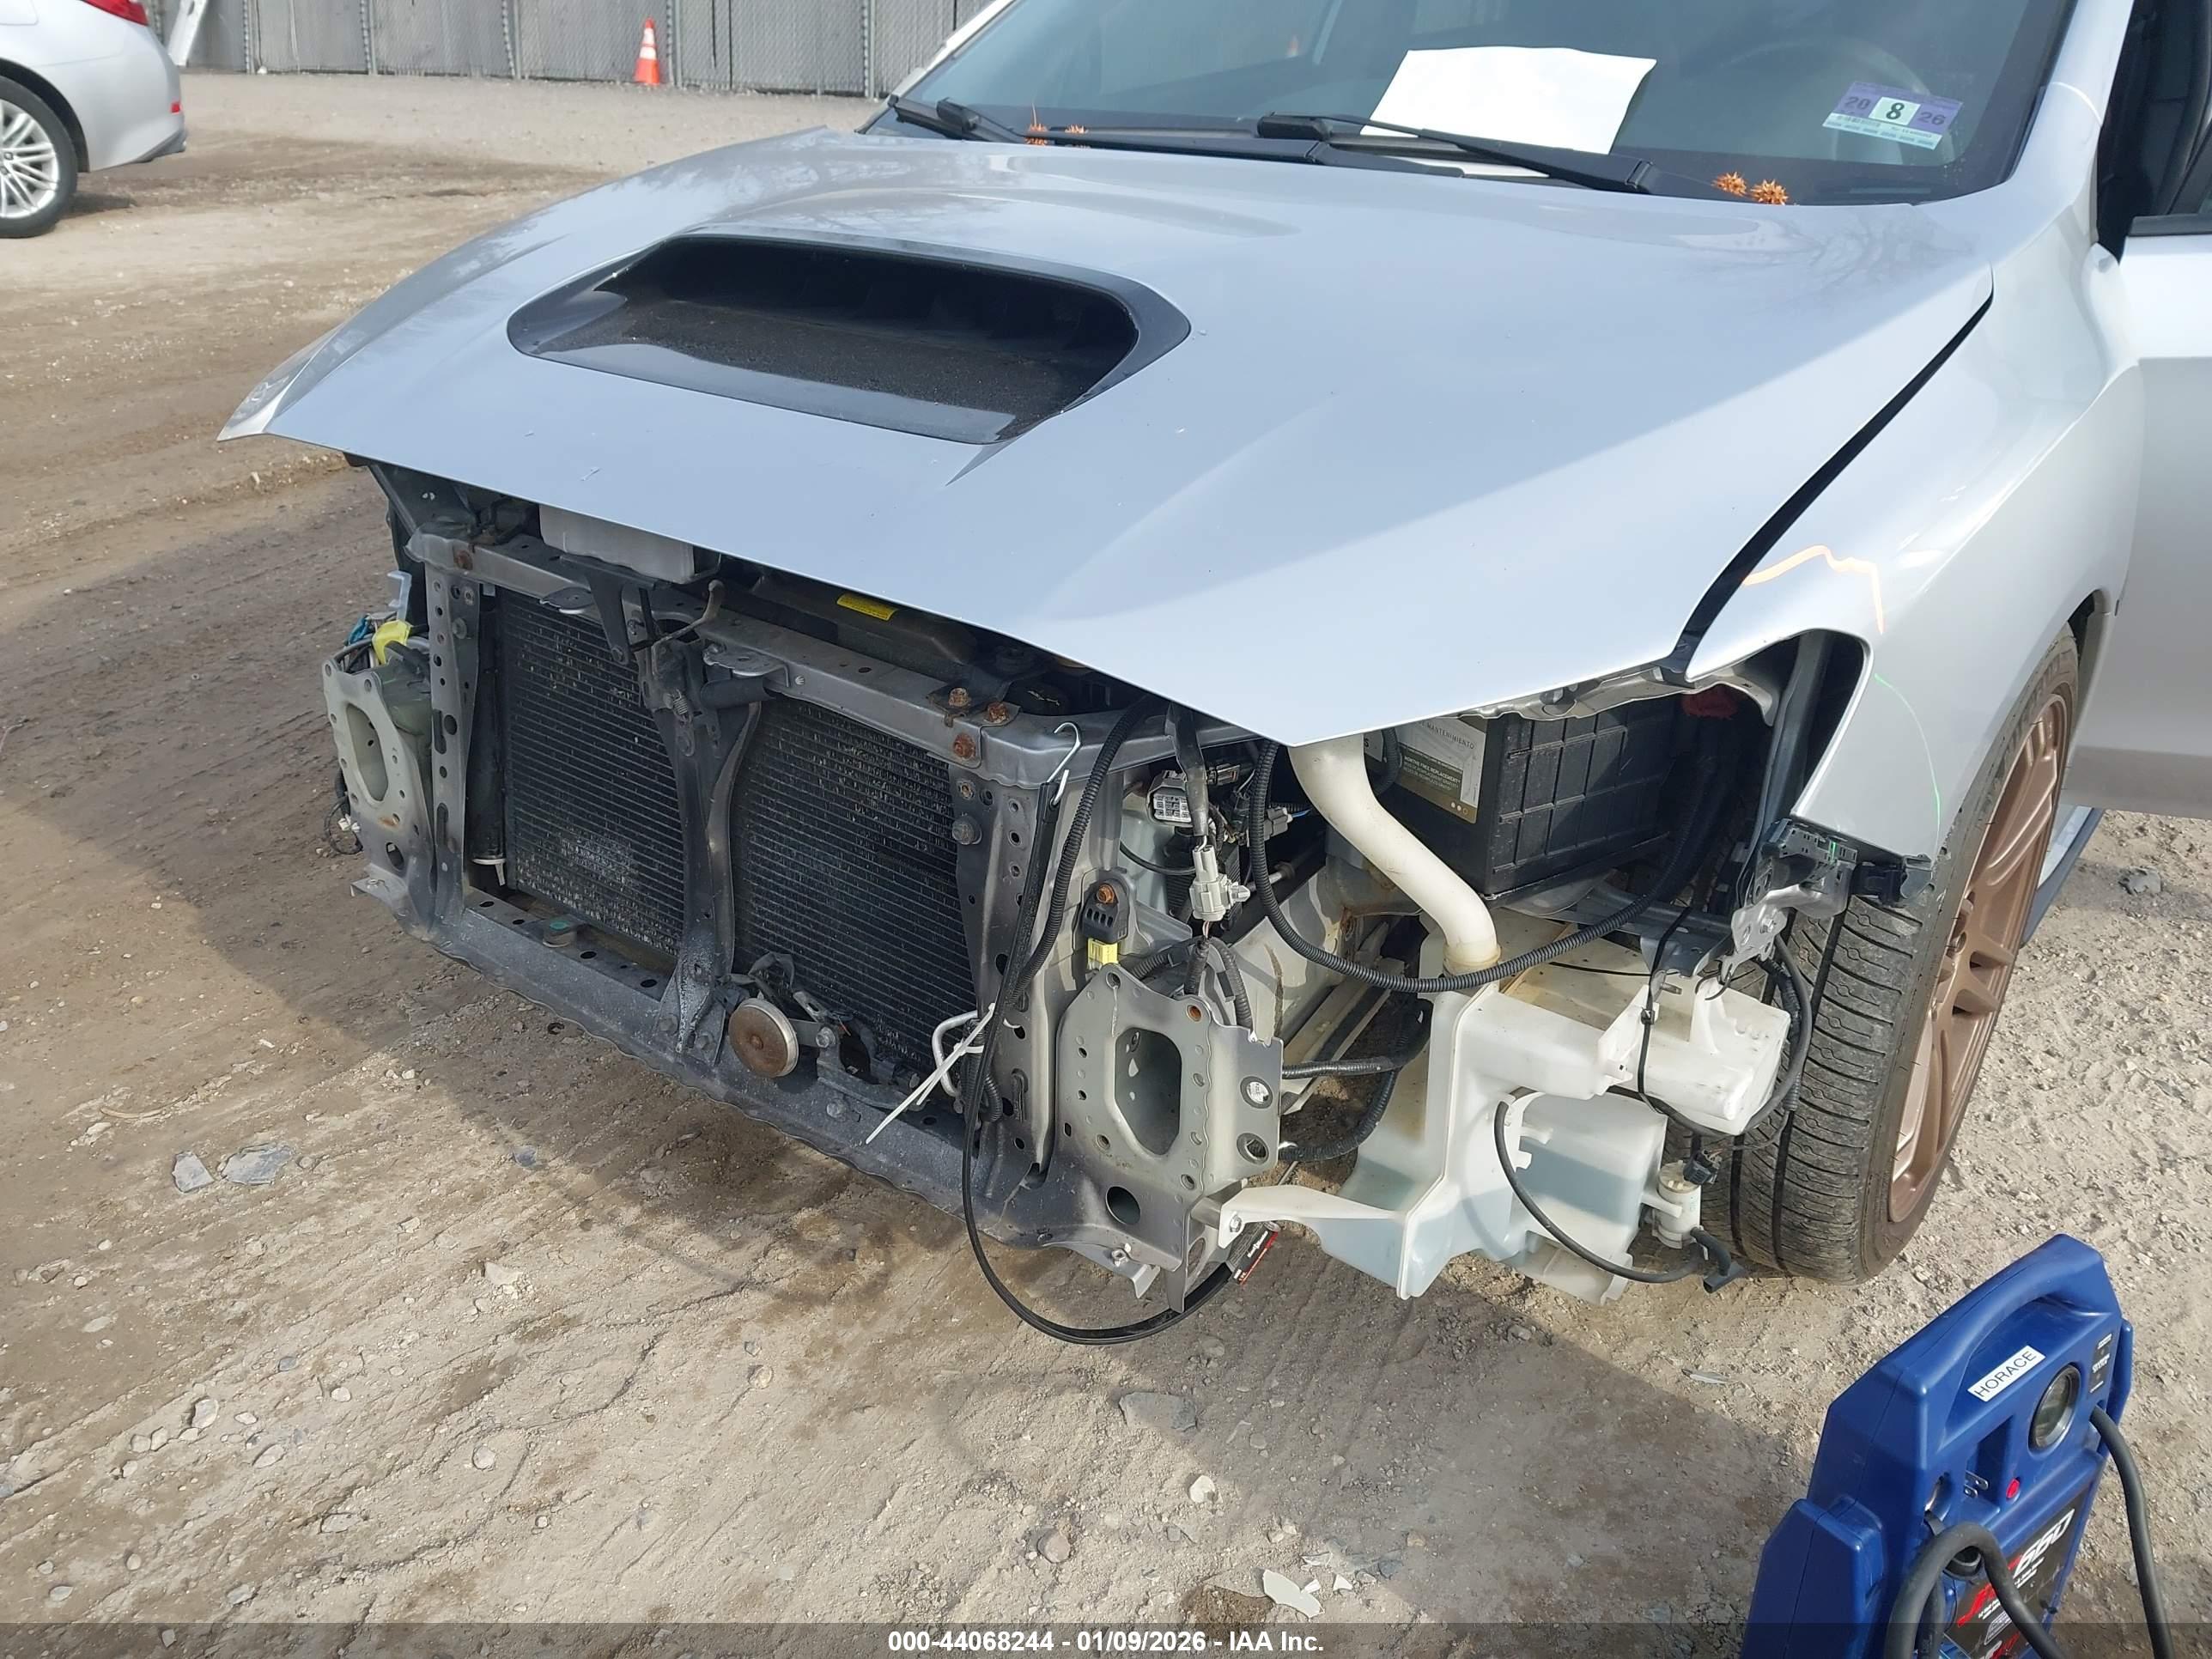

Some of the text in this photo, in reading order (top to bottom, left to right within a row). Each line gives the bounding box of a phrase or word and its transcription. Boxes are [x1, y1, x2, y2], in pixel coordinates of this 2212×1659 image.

[1844, 95, 1871, 110] 20
[1886, 102, 1905, 120] 8
[1918, 112, 1947, 125] 26
[1973, 1351, 2037, 1397] HORACE
